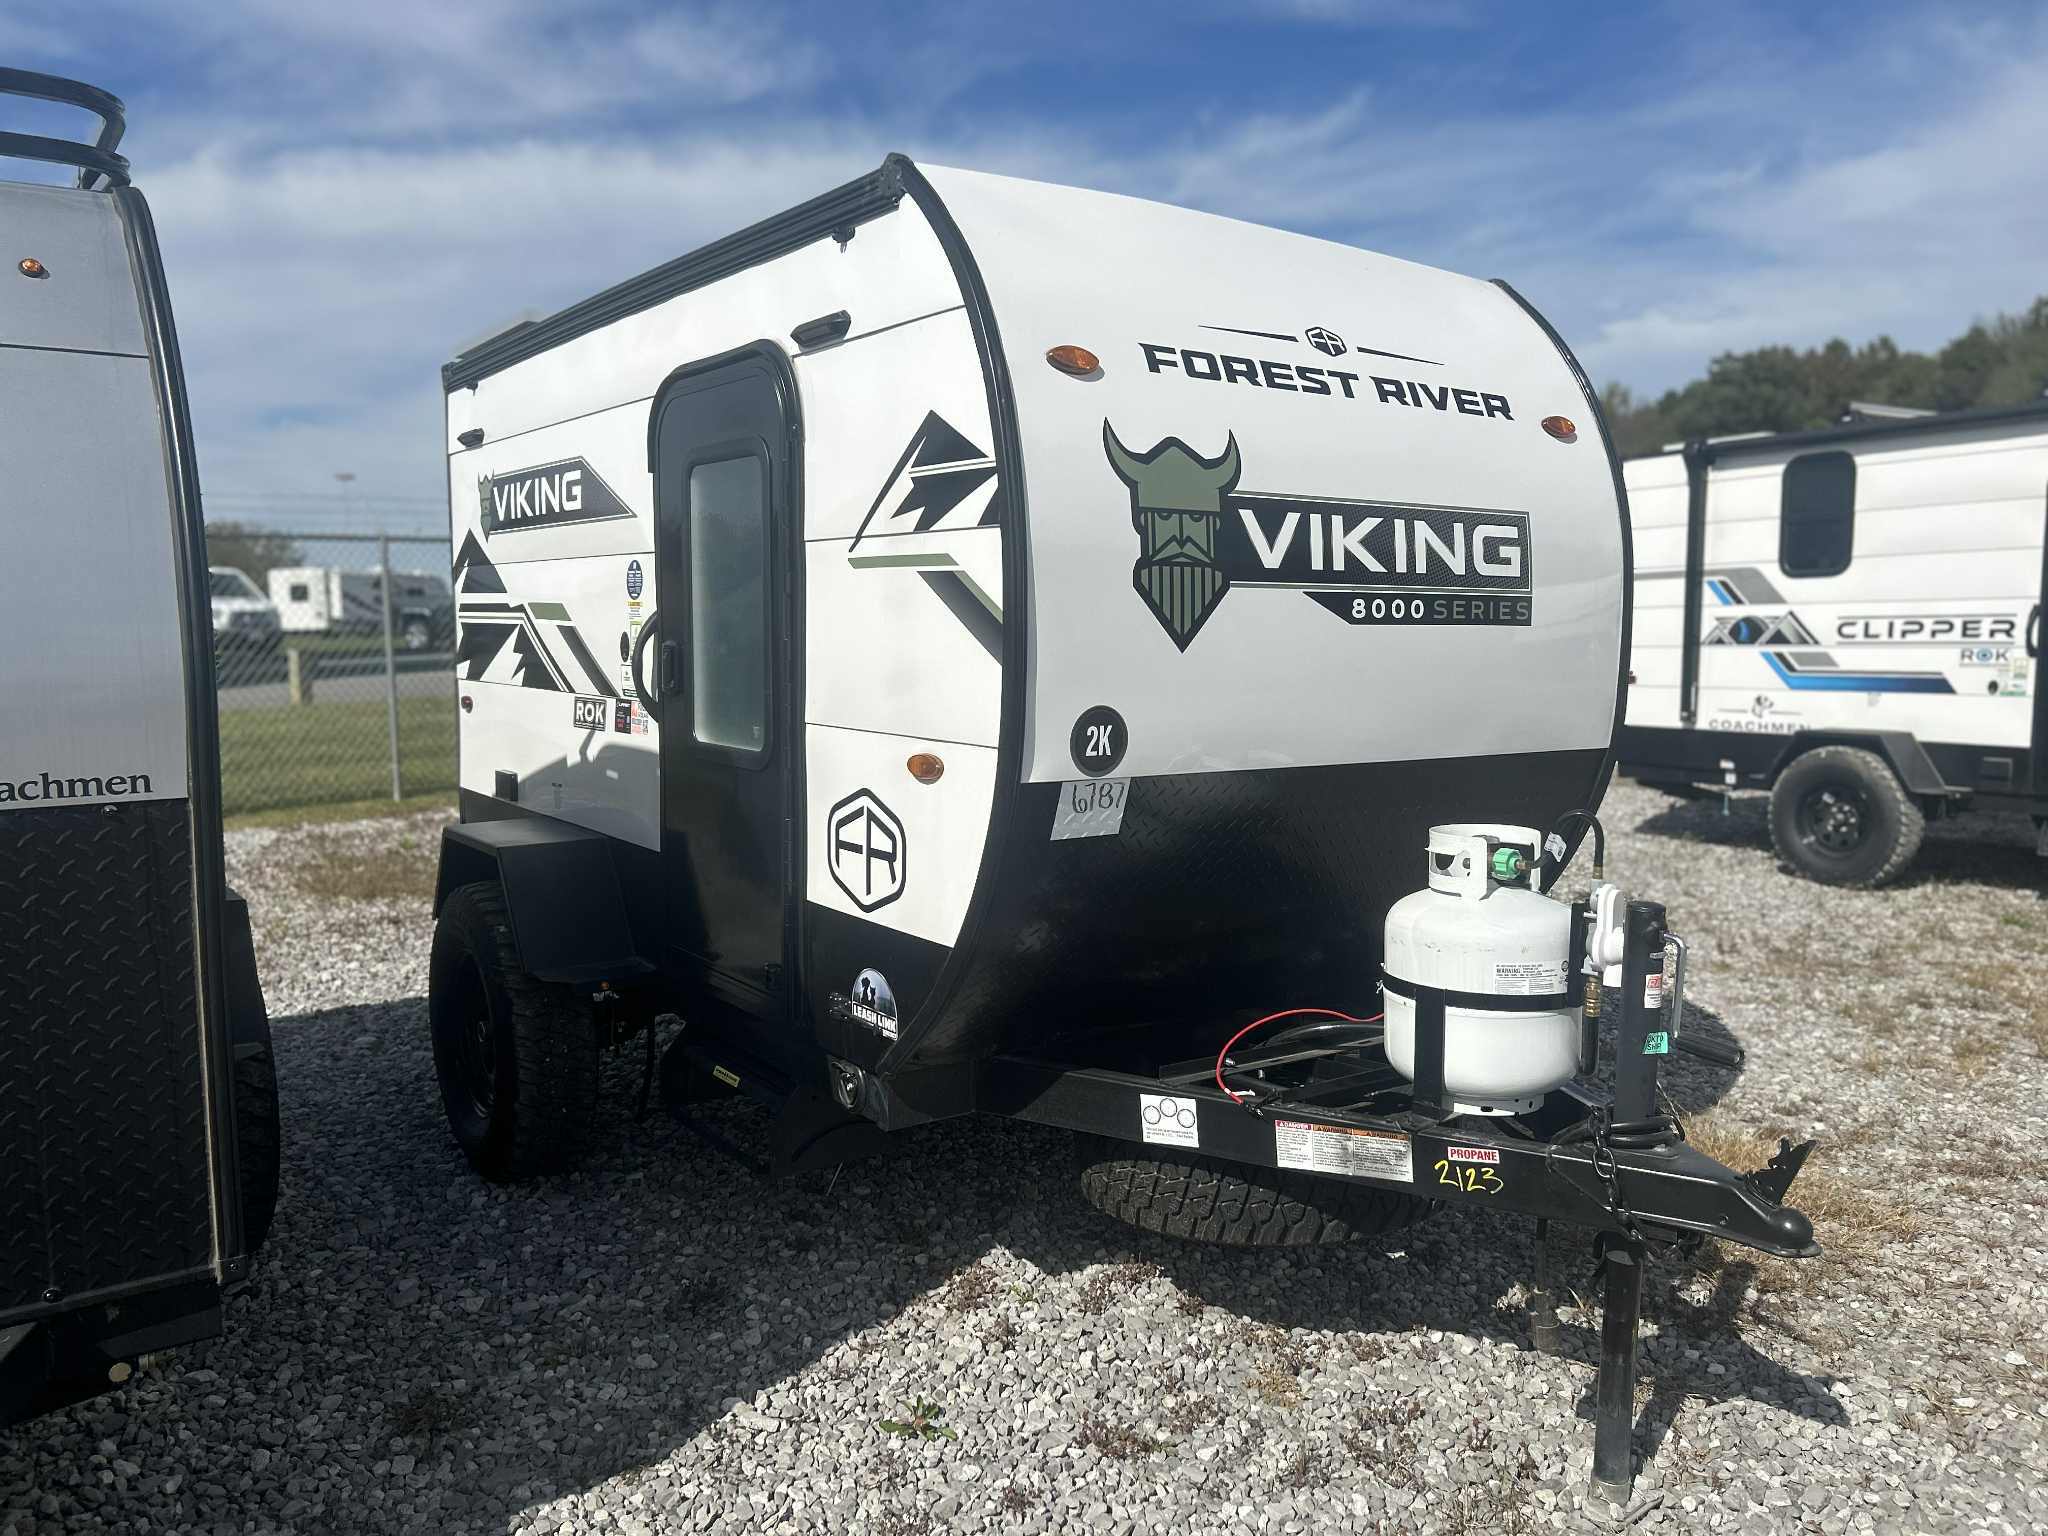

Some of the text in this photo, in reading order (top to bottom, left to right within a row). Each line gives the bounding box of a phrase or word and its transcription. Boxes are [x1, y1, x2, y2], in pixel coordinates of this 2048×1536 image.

[1138, 342, 1515, 421] FOREST RIVER
[492, 470, 582, 522] VIKING
[1237, 508, 1521, 578] VIKING
[1351, 598, 1530, 621] 8000 SERIES
[1837, 619, 2016, 640] CLIPPER
[575, 700, 605, 724] ROK
[1708, 719, 1811, 732] COACHMEN
[1085, 724, 1113, 757] 2K
[853, 1004, 896, 1033] LEASH LINK
[1450, 1148, 1498, 1161] PROPANE
[1434, 1160, 1504, 1194] 2123
